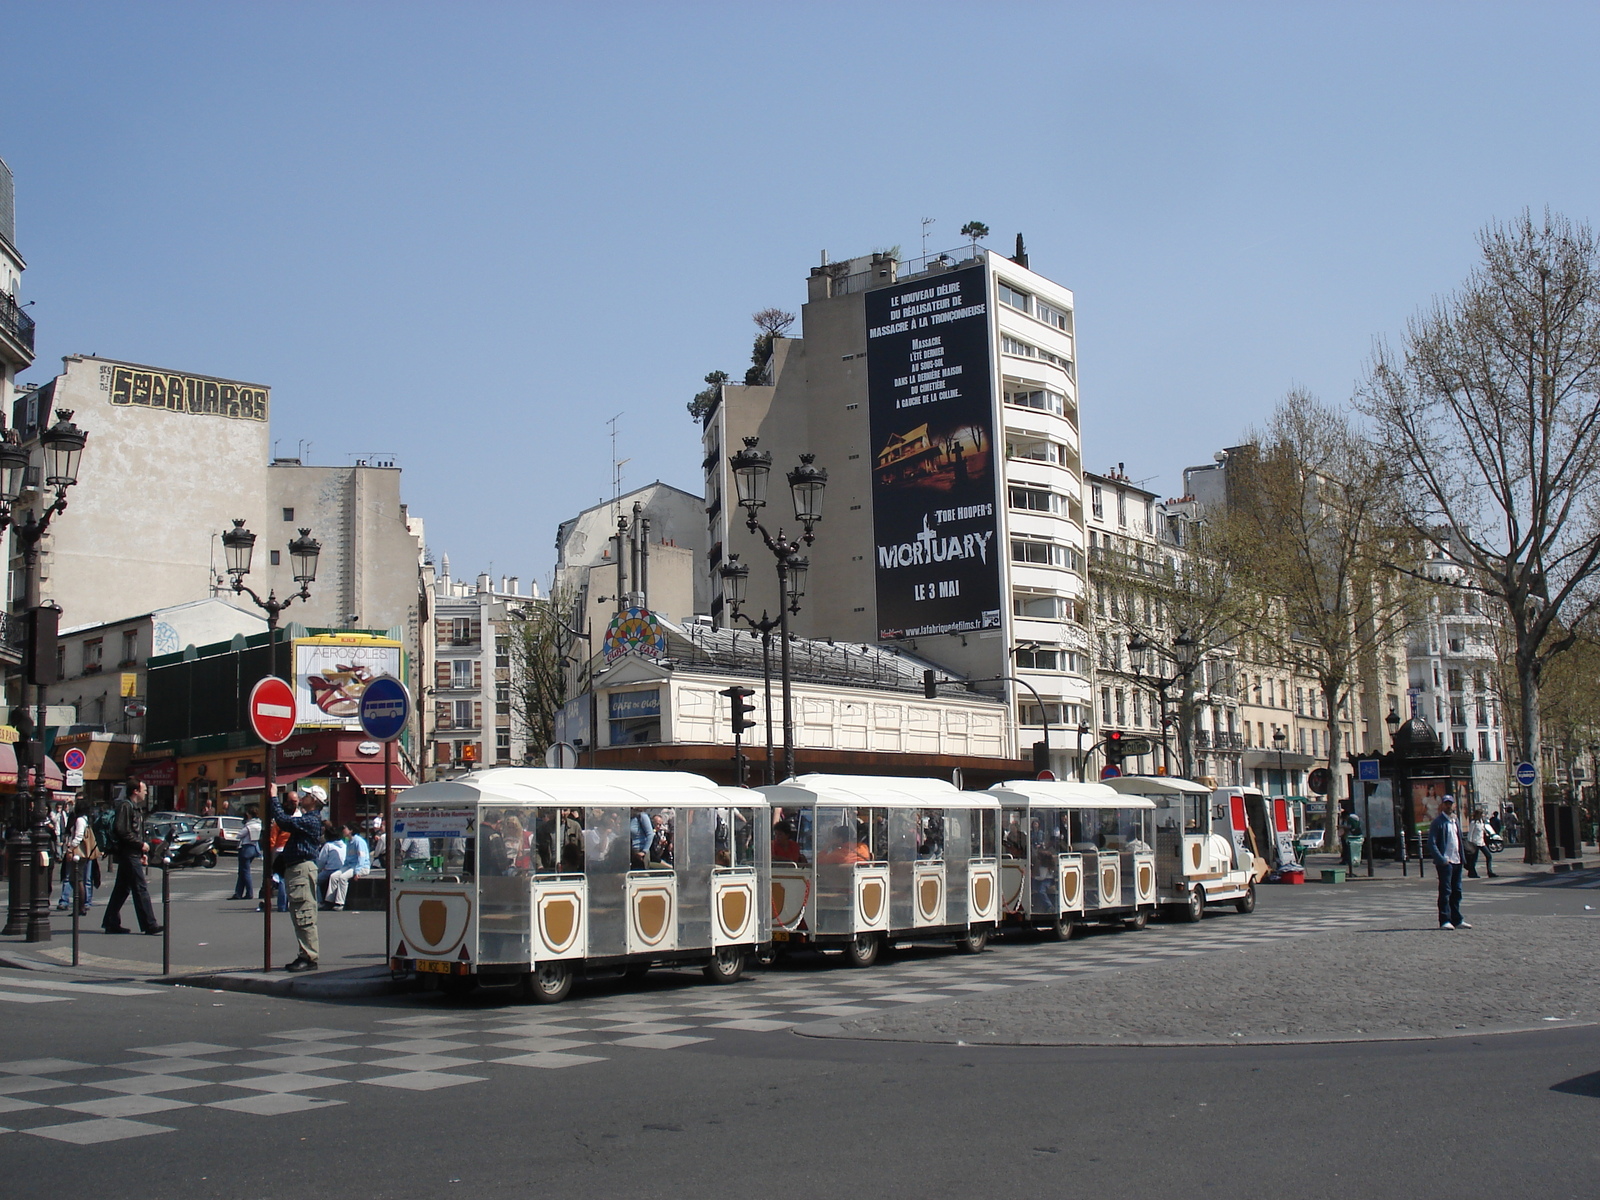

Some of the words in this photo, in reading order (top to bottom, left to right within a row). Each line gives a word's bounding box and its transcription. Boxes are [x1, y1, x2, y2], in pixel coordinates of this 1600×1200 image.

[891, 296, 899, 307] LE
[901, 288, 934, 305] NOUVEAU
[936, 282, 960, 296] DÉLIRE
[890, 310, 901, 320] DU
[903, 299, 950, 318] RÉALISATEUR
[952, 295, 962, 307] DE
[869, 321, 909, 338] MASSACRE
[911, 318, 917, 330] À
[919, 318, 928, 328] LA
[930, 304, 986, 324] TRONÇONNEUSE
[924, 346, 944, 359] DERNIER
[912, 363, 919, 373] AU
[920, 358, 944, 371] SOUS-SOL
[894, 376, 908, 387] DANS
[910, 375, 916, 384] LA
[917, 369, 940, 382] DERNIÈRE
[942, 365, 962, 378] MAISON
[911, 386, 918, 395] DU
[920, 380, 946, 393] CIMETIÈRE
[902, 396, 921, 408] GAUCHE
[922, 394, 929, 404] DE
[930, 393, 937, 402] LA
[957, 503, 992, 520] HOOPER'S
[878, 513, 993, 568] MORTUARY
[914, 584, 925, 601] LE
[929, 583, 935, 599] 3
[939, 580, 960, 598] MAI
[607, 646, 627, 662] CUBA
